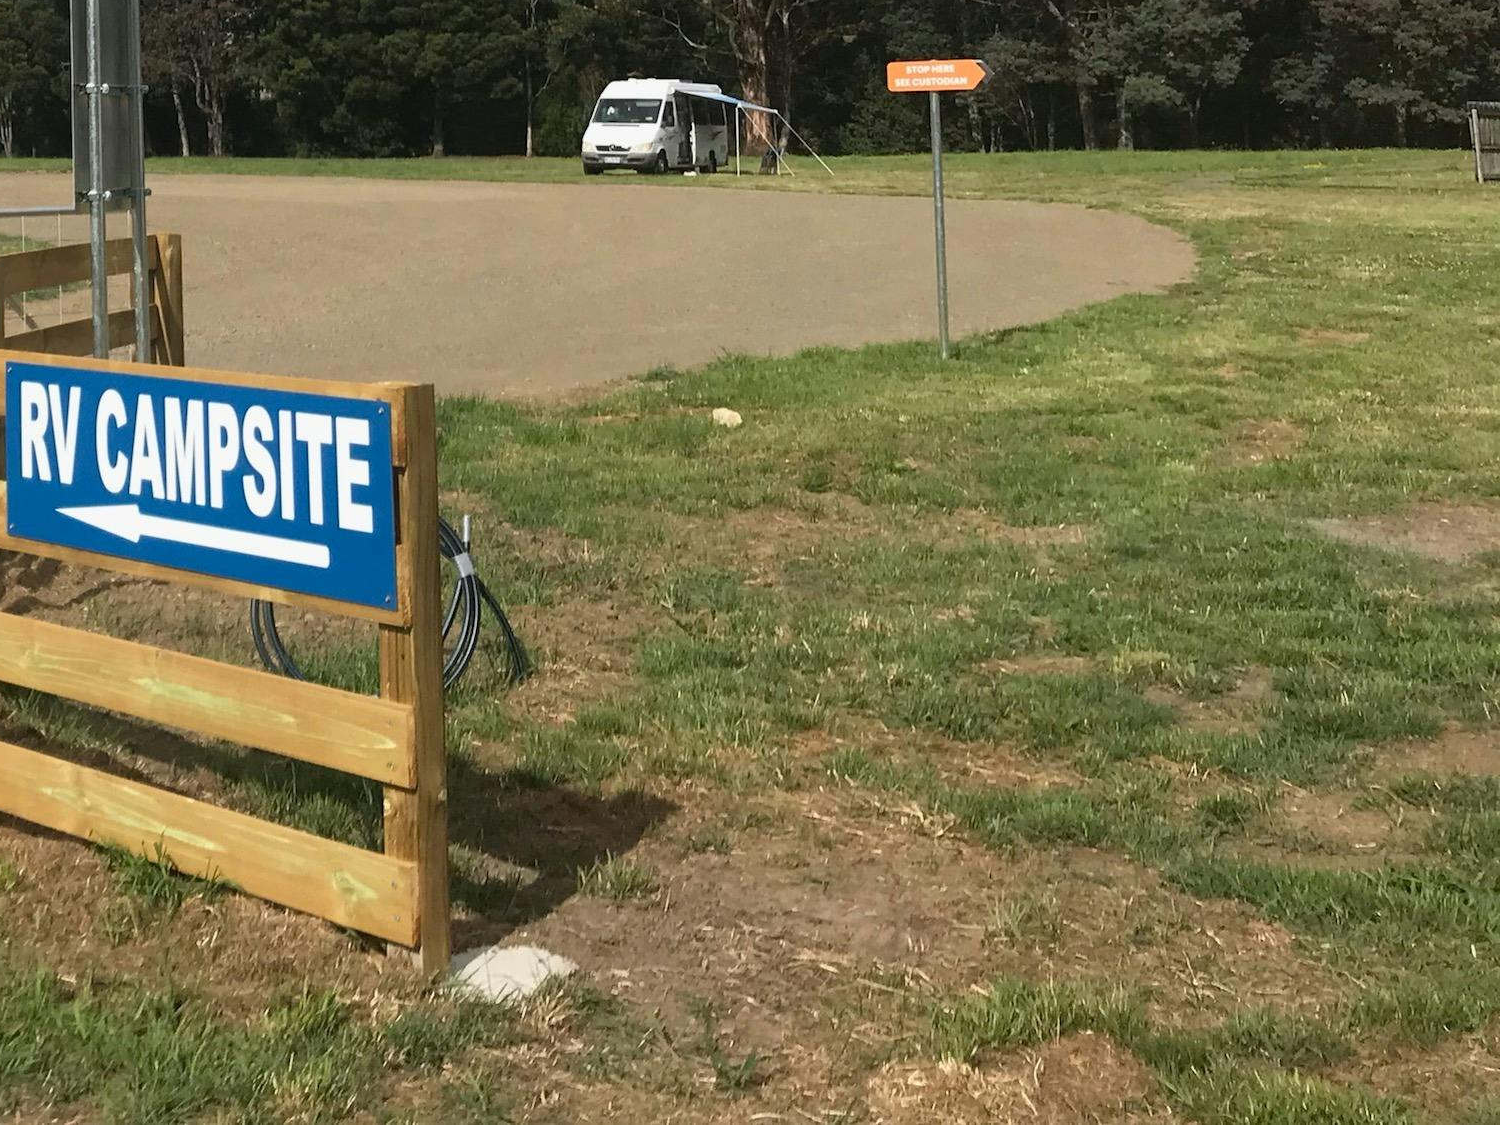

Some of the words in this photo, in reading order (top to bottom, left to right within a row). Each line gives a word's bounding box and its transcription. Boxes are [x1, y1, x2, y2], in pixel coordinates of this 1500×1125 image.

[906, 65, 931, 74] STOP
[932, 64, 955, 73] HERE
[894, 78, 910, 87] SEE
[911, 76, 968, 87] CUSTODIAN
[20, 380, 82, 485] RV
[96, 388, 374, 534] CAMPSITE
